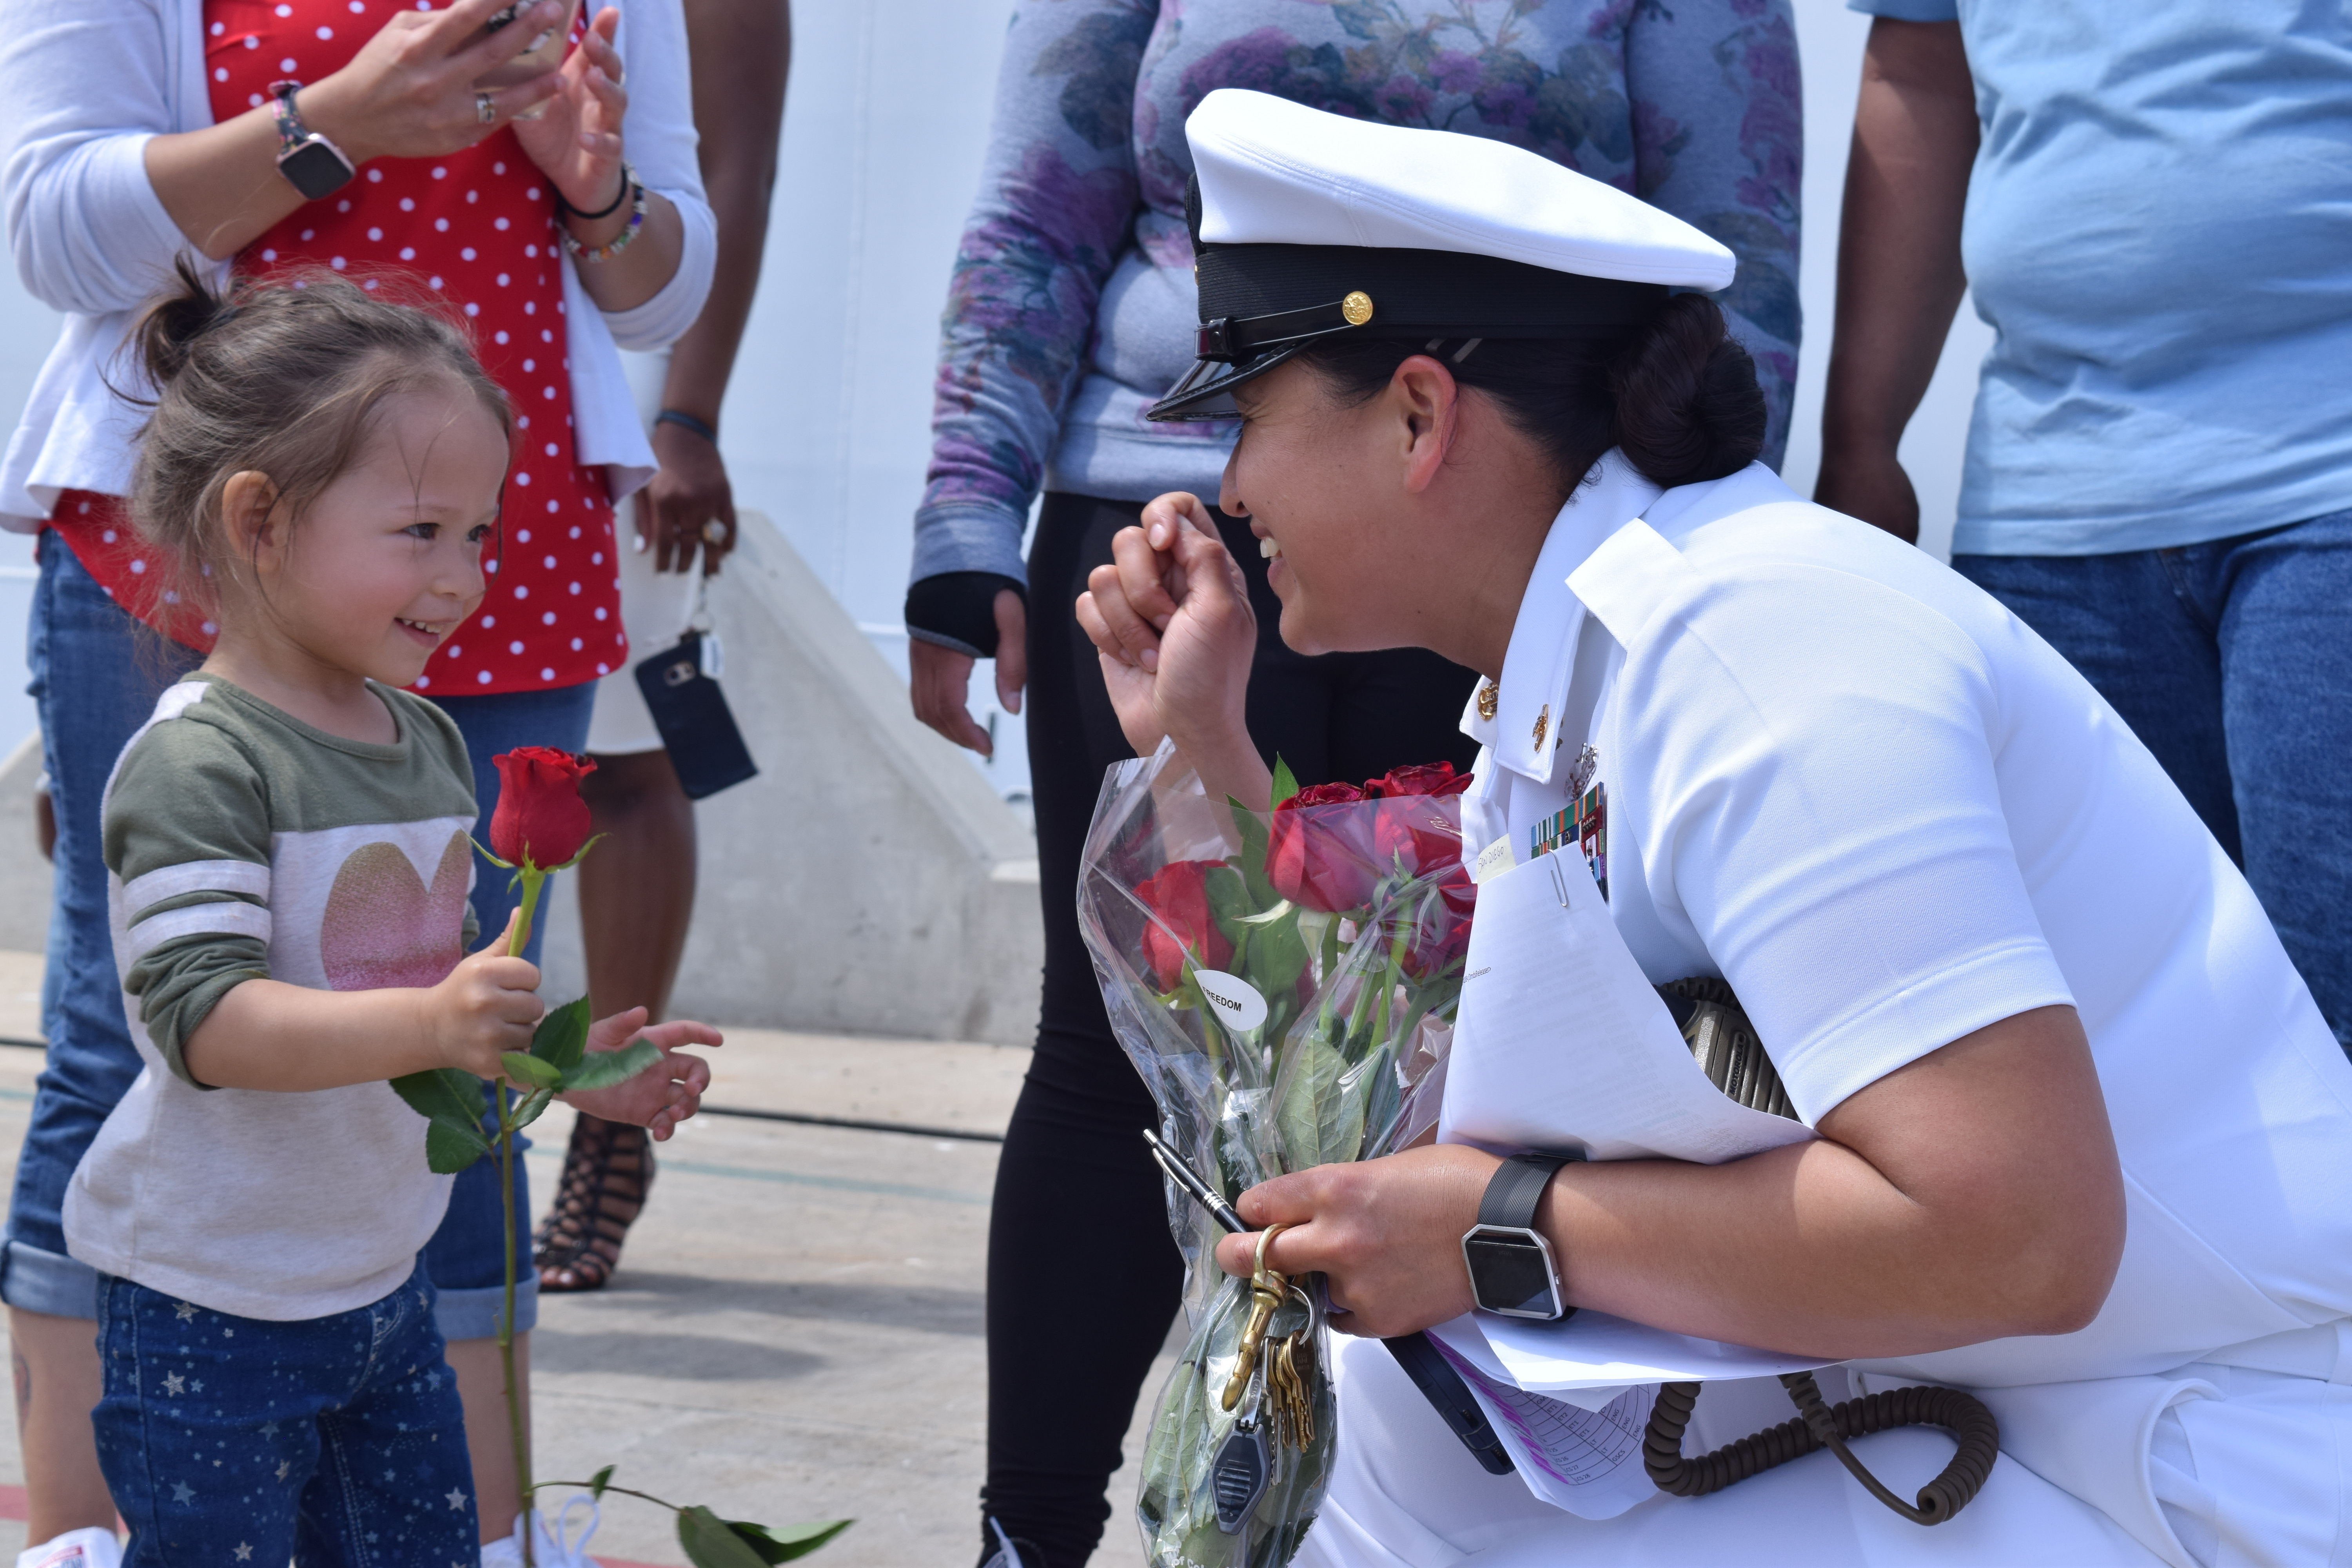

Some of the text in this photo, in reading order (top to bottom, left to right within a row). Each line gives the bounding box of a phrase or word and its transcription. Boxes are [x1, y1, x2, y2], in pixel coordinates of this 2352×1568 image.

[1478, 846, 1504, 874] SAN DIEGO
[1202, 986, 1242, 1012] FREEDOM
[1730, 1044, 1744, 1096] MOTOROLA
[1250, 1383, 1259, 1399] NITE
[1537, 1396, 1549, 1404] GM
[1558, 1412, 1568, 1421] ET2
[1611, 1408, 1619, 1421] ENG
[1568, 1421, 1579, 1429] ET1
[1622, 1416, 1630, 1429] ENG
[1579, 1429, 1590, 1437] ET1
[1633, 1424, 1641, 1437] ENG
[1612, 1449, 1625, 1461] GSCS
[1172, 1556, 1185, 1566] of
